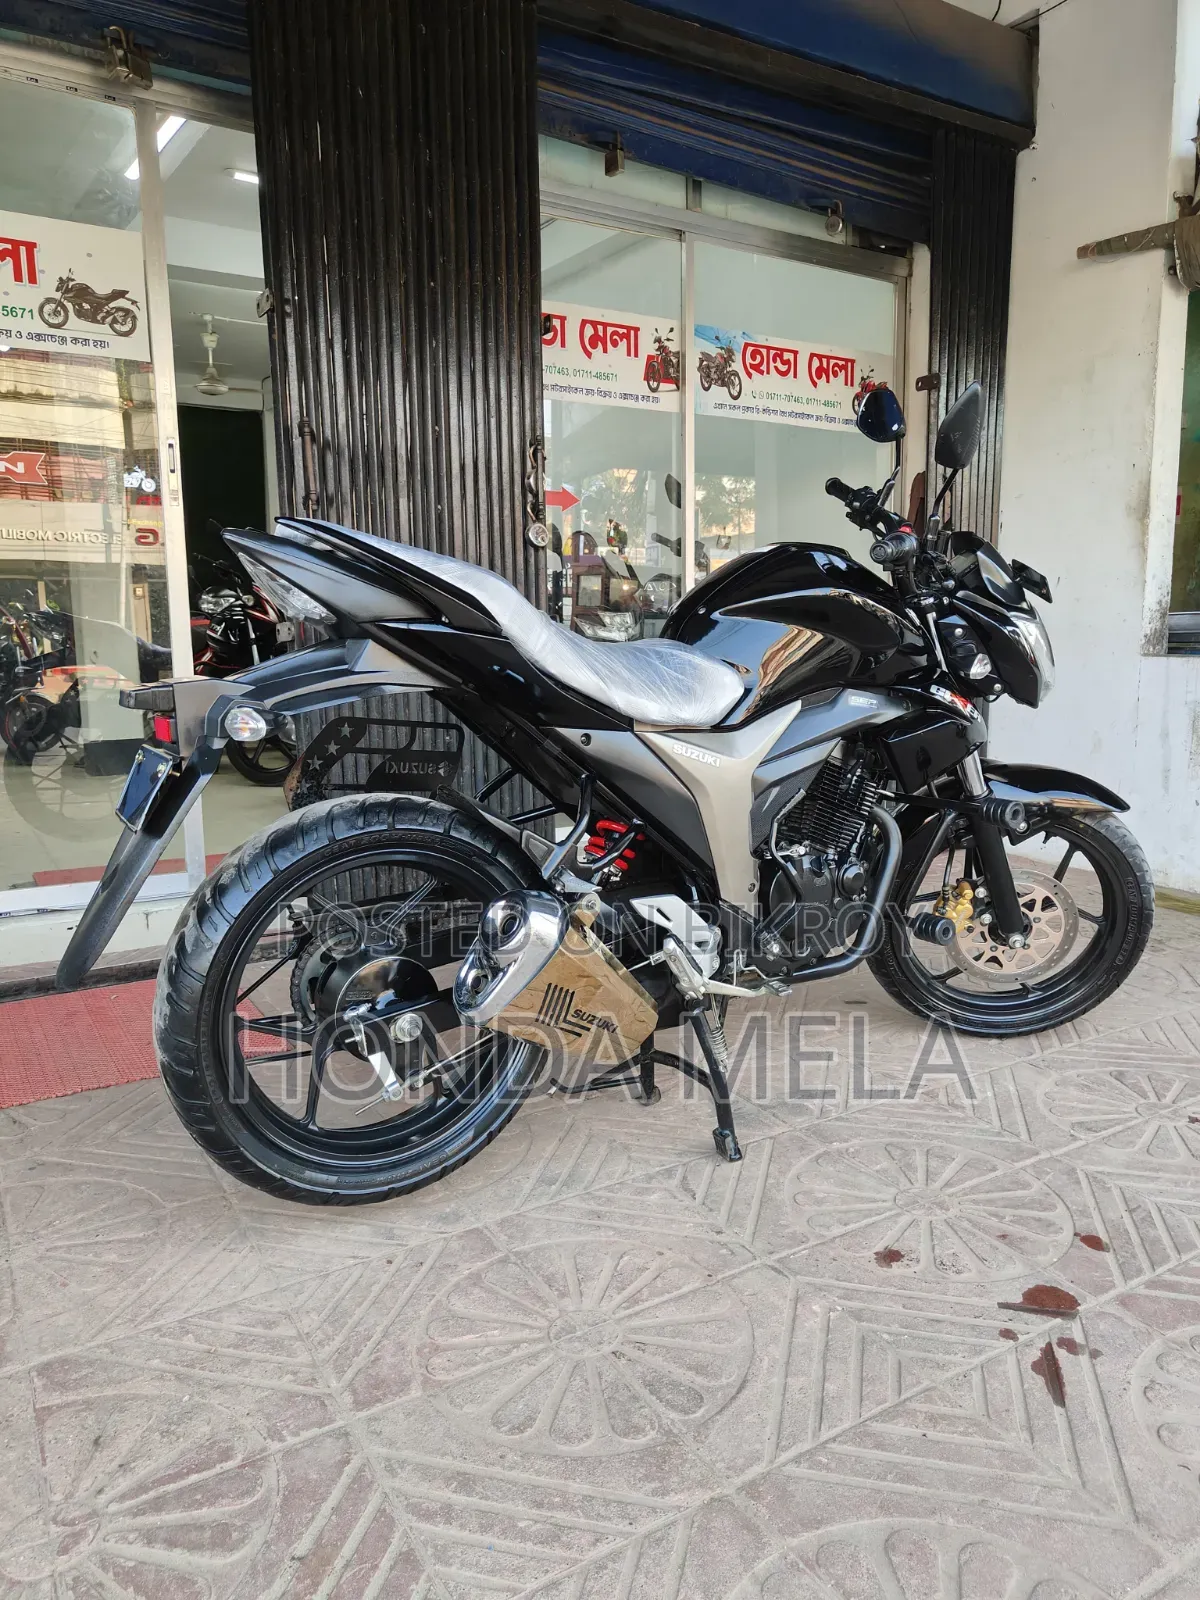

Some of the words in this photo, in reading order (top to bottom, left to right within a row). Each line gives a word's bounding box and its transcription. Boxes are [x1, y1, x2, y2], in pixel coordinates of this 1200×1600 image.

[15, 331, 24, 340] ও
[70, 336, 91, 348] করা
[578, 318, 641, 360] মেলা
[741, 341, 799, 380] হোন্ডা
[807, 352, 856, 389] মেলা
[672, 743, 721, 768] SUZUKI
[571, 1009, 618, 1034] SUZUKI
